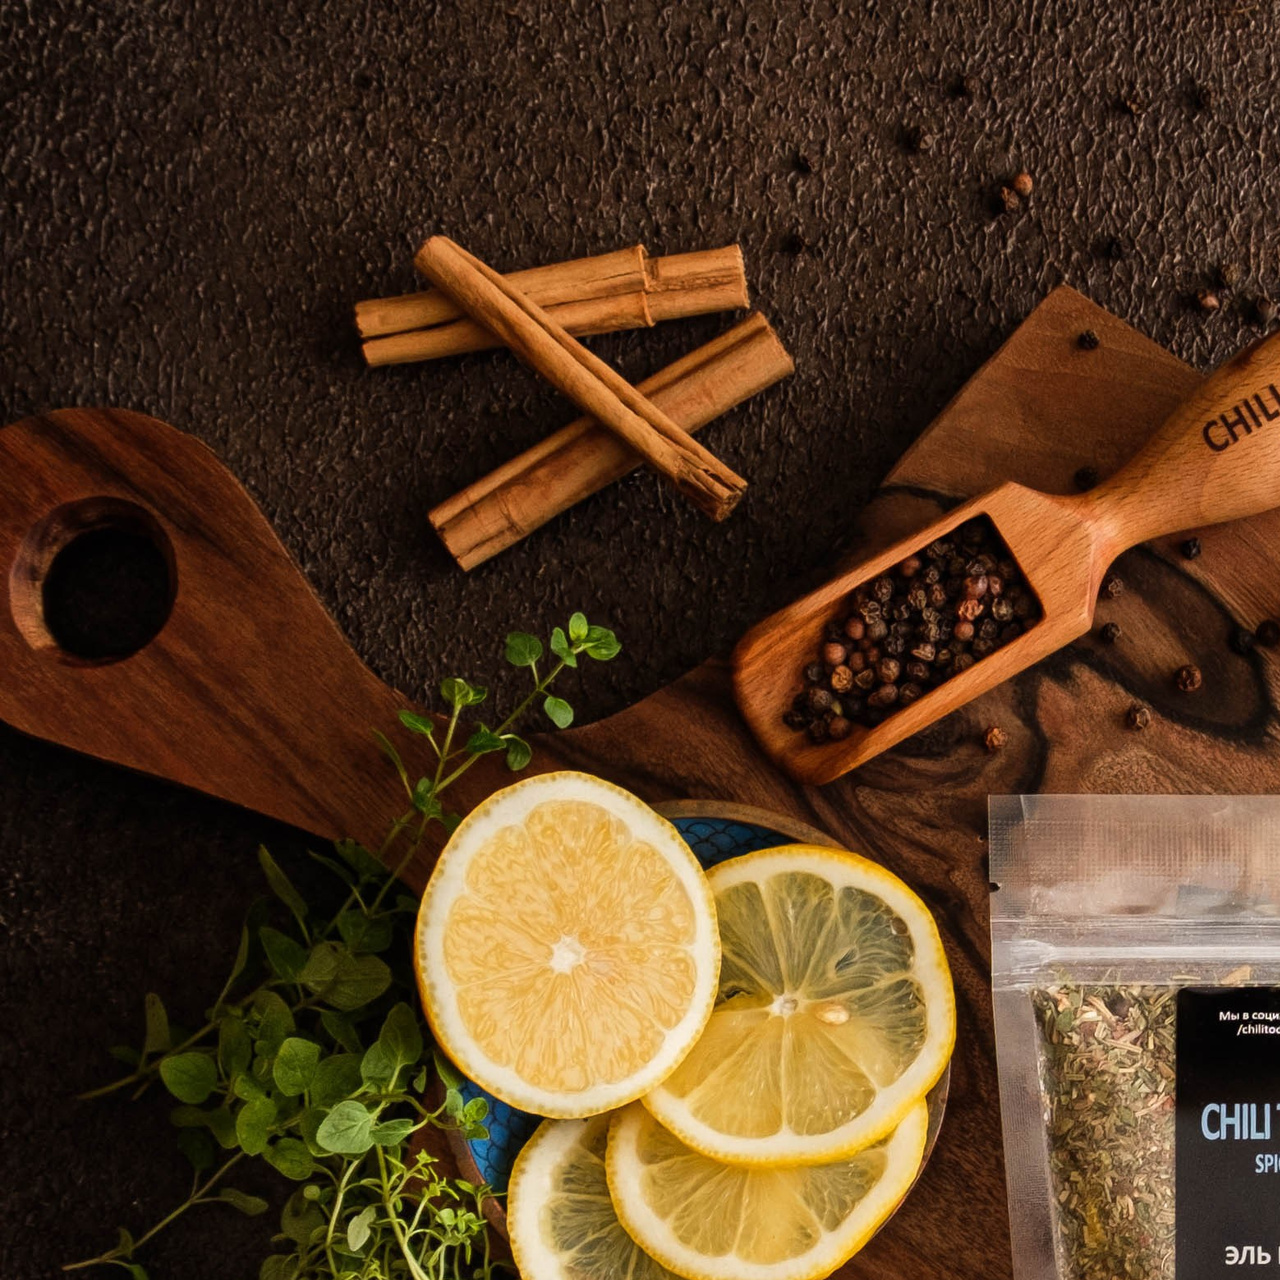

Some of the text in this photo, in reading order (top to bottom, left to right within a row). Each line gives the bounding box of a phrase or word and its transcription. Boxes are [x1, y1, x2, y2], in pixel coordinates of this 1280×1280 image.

[1219, 1011, 1240, 1021] Мы
[1242, 1012, 1250, 1021] в
[1200, 1103, 1271, 1141] CHILI
[1225, 1246, 1271, 1265] ЭЛЬ
